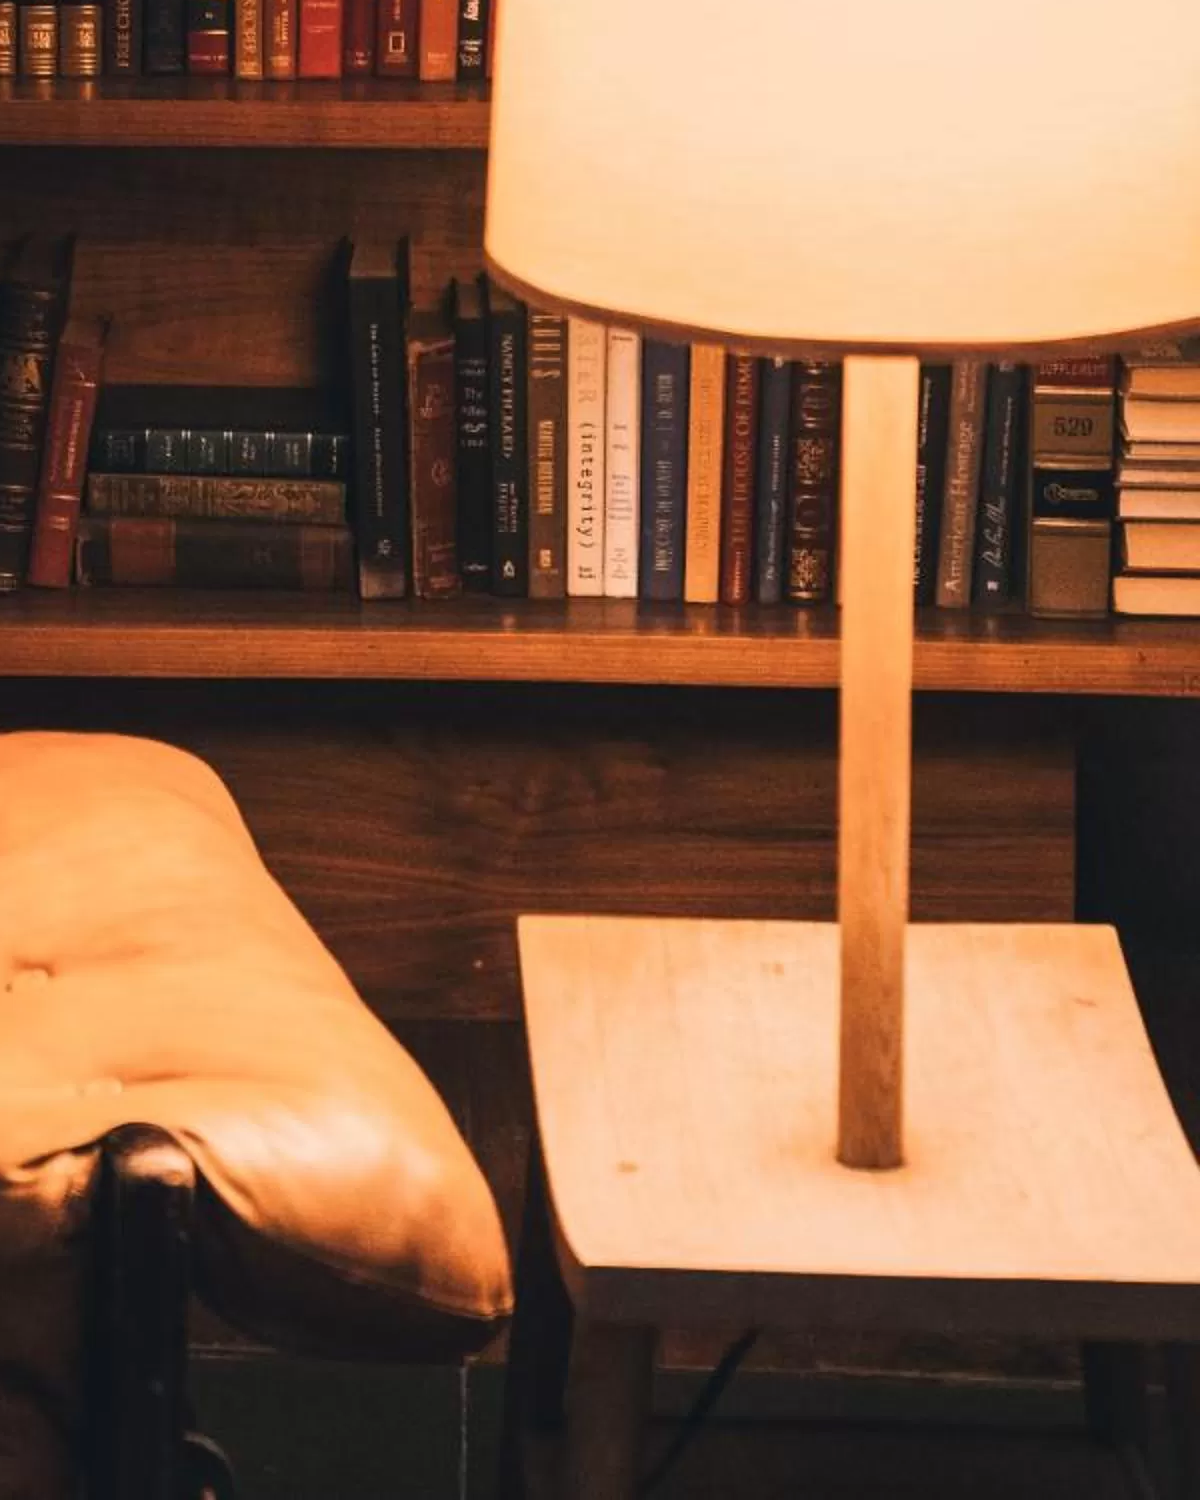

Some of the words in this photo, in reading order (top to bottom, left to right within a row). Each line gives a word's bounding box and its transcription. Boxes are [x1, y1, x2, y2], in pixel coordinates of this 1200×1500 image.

[501, 333, 513, 383] NANCY
[733, 409, 749, 436] OF
[577, 421, 596, 550] (integrity)
[732, 441, 749, 502] HOUSE
[945, 501, 966, 594] American
